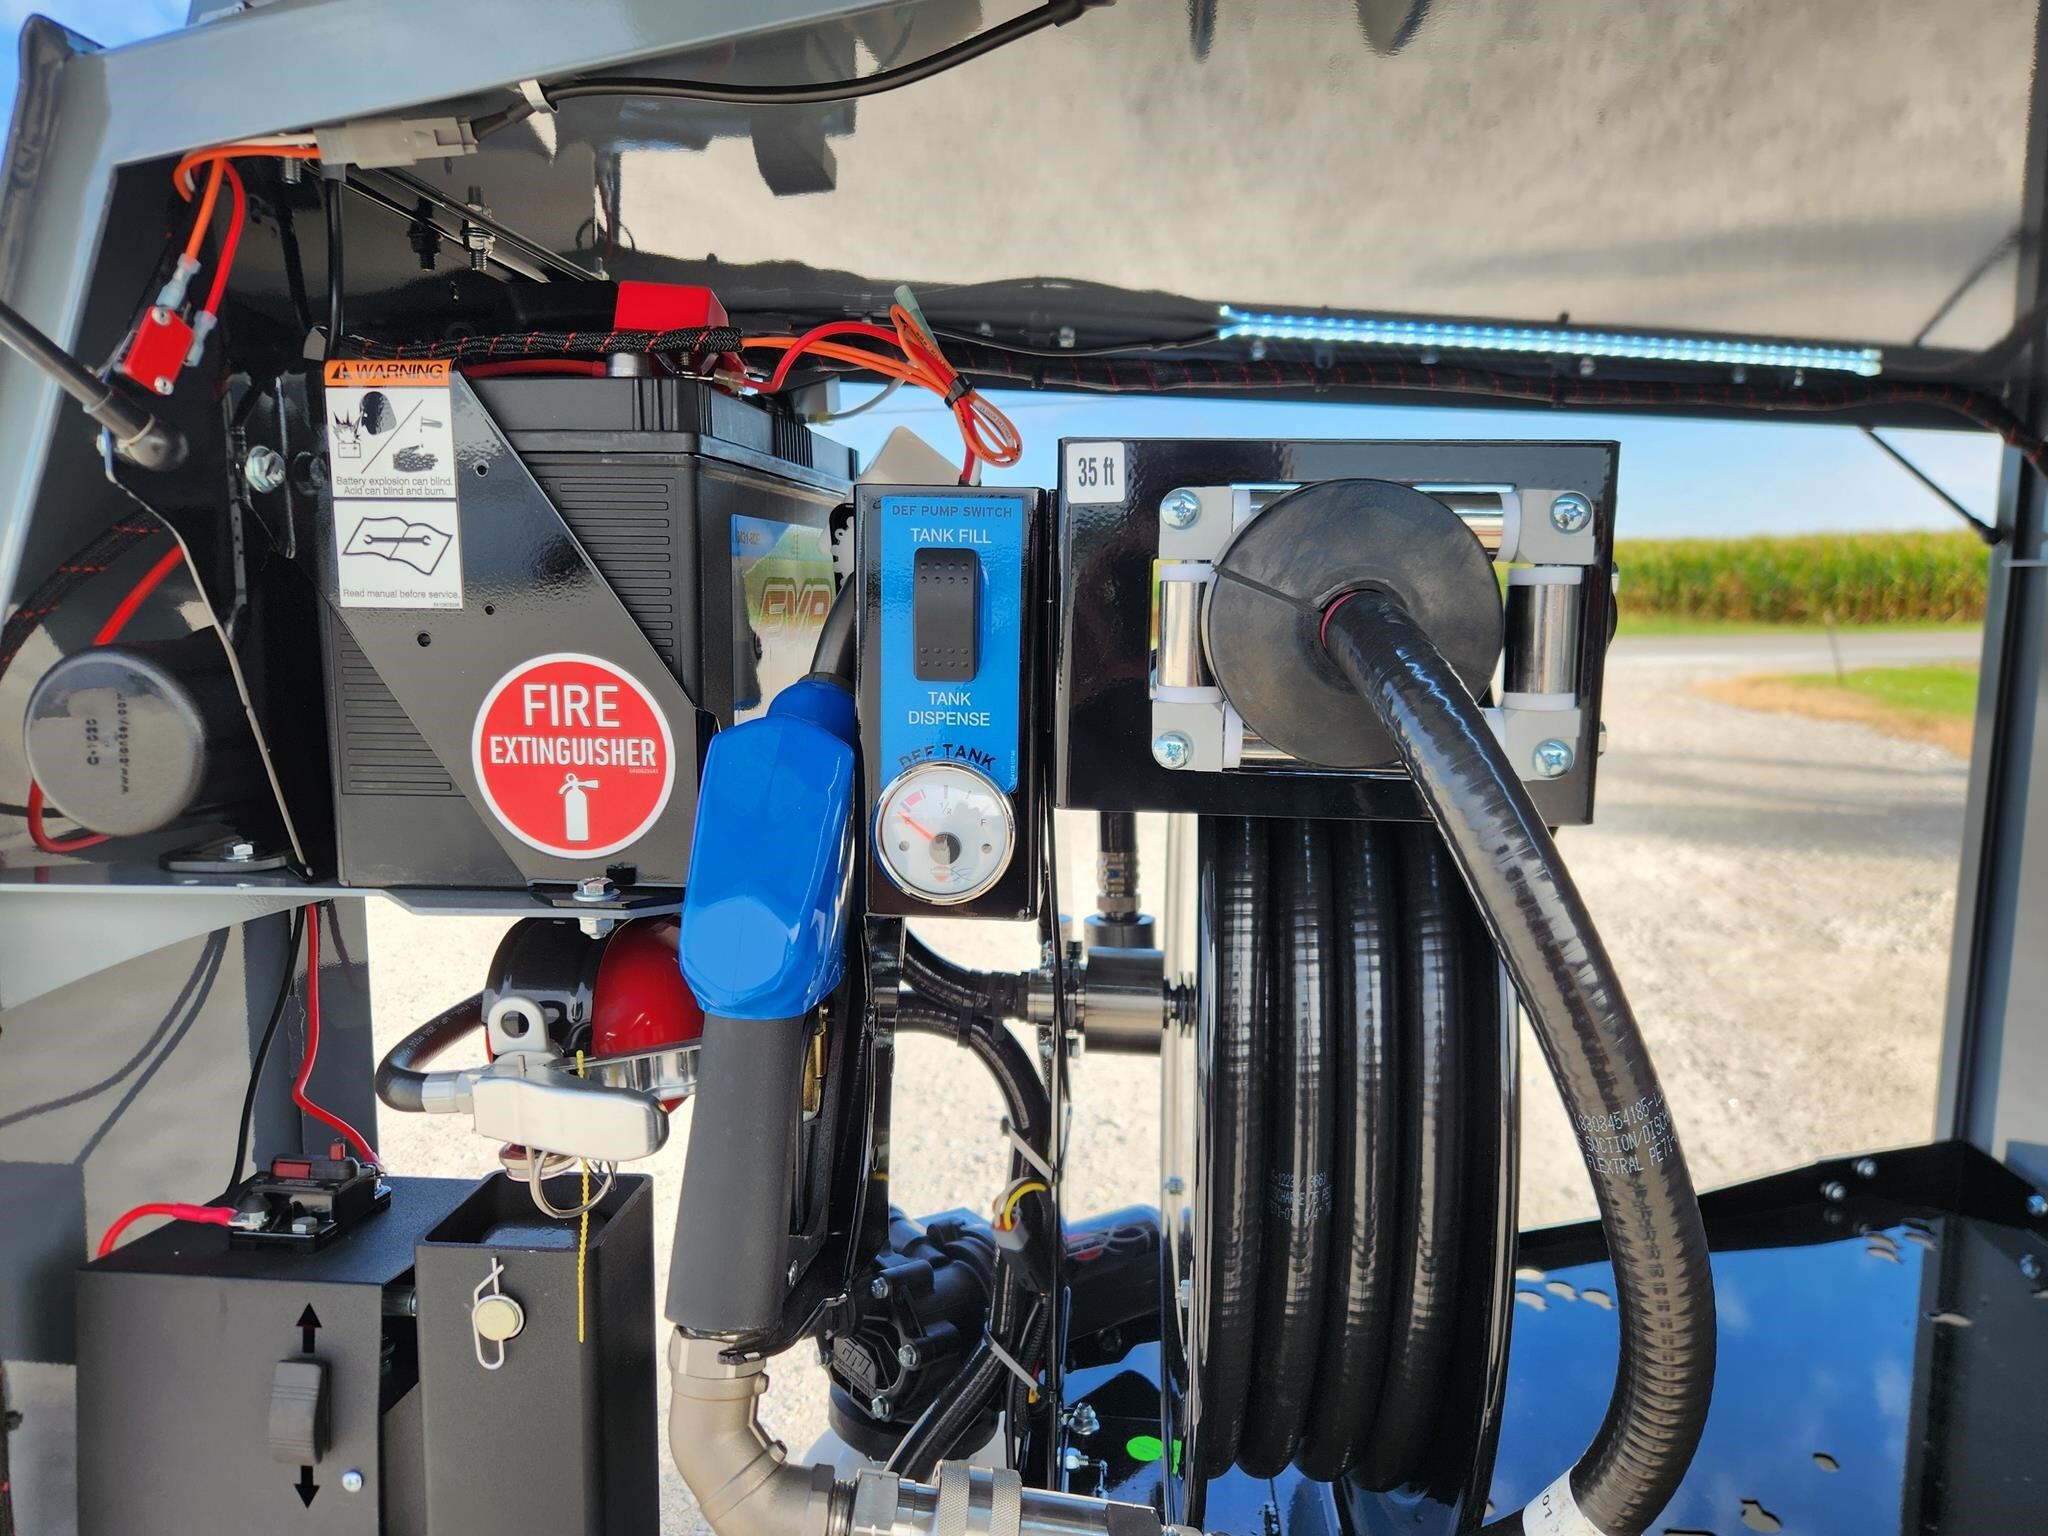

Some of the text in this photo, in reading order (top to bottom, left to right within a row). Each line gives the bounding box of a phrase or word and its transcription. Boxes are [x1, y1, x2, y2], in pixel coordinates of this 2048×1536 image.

[355, 363, 443, 379] WARNING
[1078, 456, 1114, 487] 35 ft
[336, 476, 454, 488] Battery explosion can blind.
[344, 486, 363, 496] Acid
[365, 487, 380, 496] can
[383, 486, 404, 496] blind
[406, 486, 422, 496] and
[892, 504, 1013, 519] DEF PUMP SWITCH
[910, 527, 993, 544] TANK FILL
[343, 589, 365, 598] Read
[367, 589, 398, 598] manual
[400, 590, 426, 599] before
[523, 684, 621, 728] FIRE
[928, 691, 972, 706] TANK
[908, 710, 991, 726] DISPENSE
[490, 736, 657, 767] EXTINGUISHER
[898, 745, 935, 768] DEF
[942, 743, 997, 771] TANK
[980, 818, 988, 827] F
